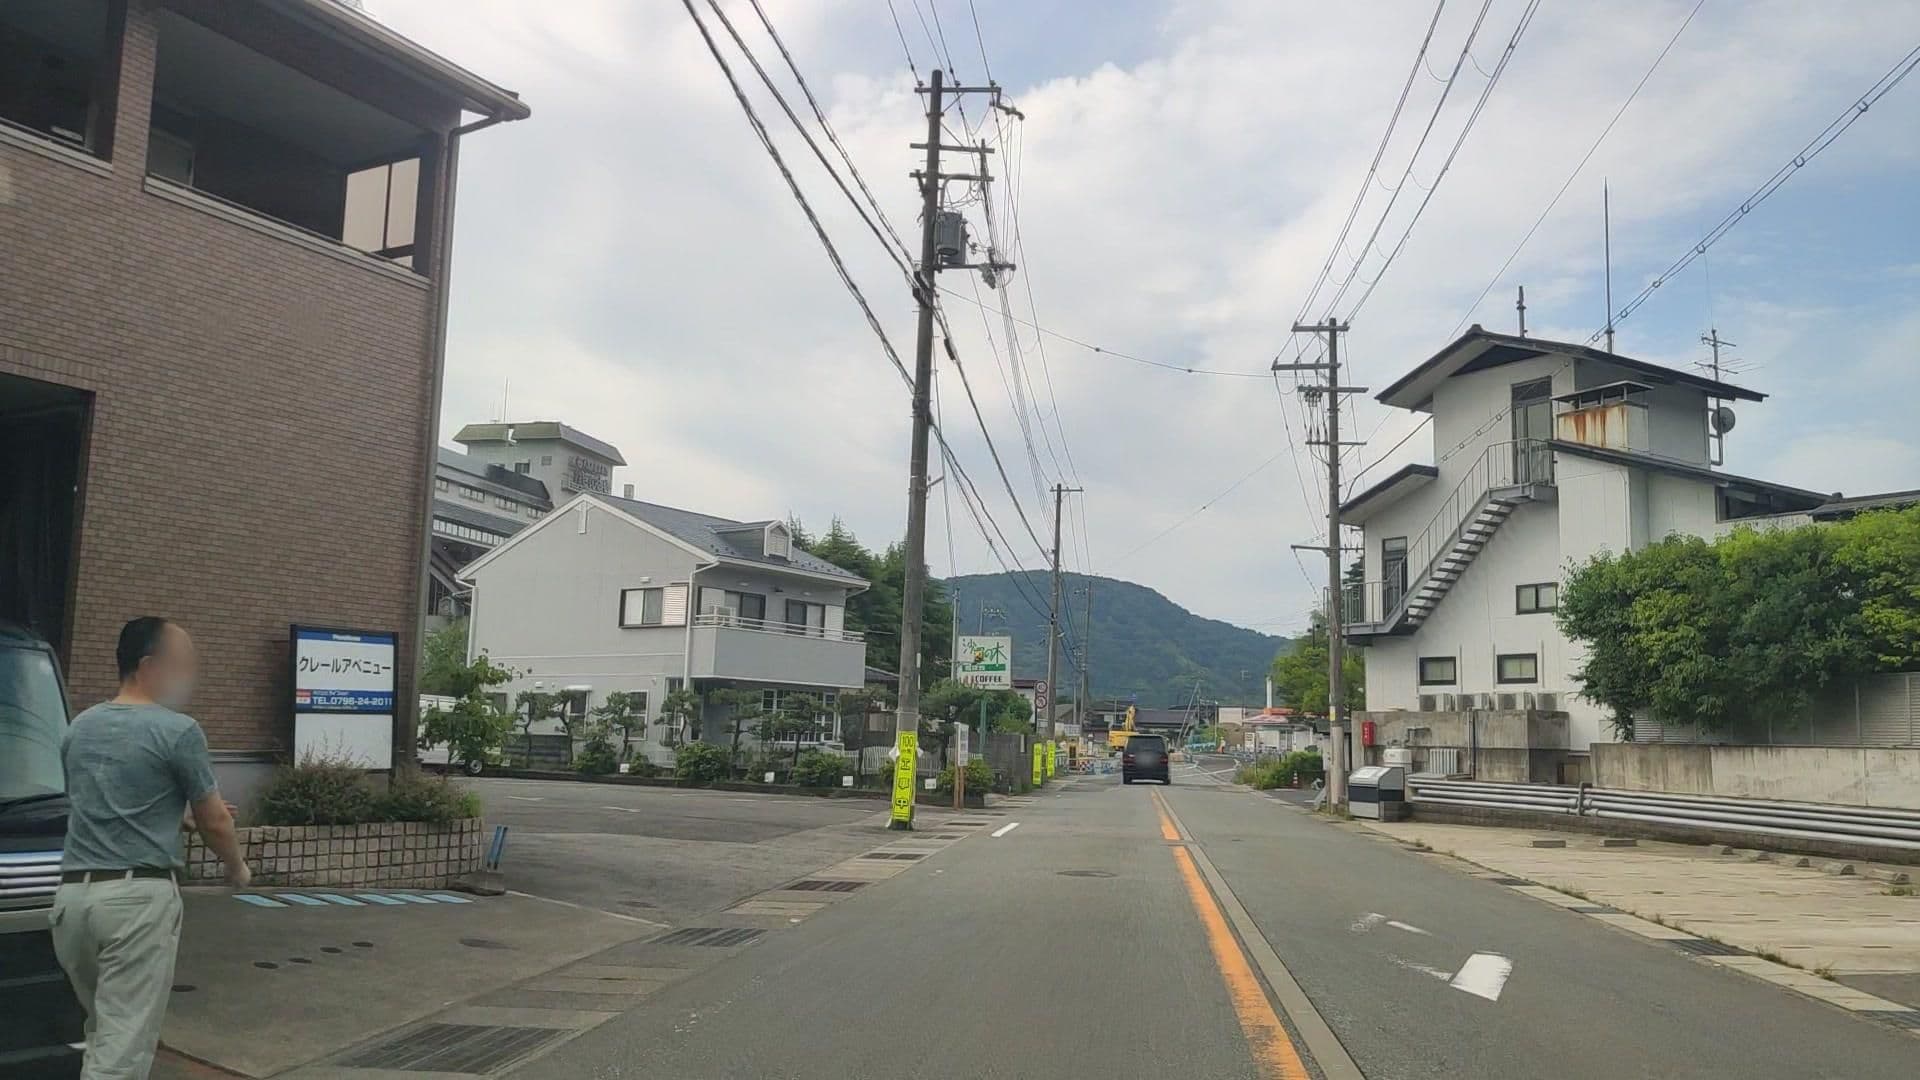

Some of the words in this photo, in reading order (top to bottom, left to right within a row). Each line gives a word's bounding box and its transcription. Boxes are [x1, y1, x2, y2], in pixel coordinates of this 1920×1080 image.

[299, 655, 391, 675] クレールアベニュー
[975, 675, 1001, 683] COFFEE
